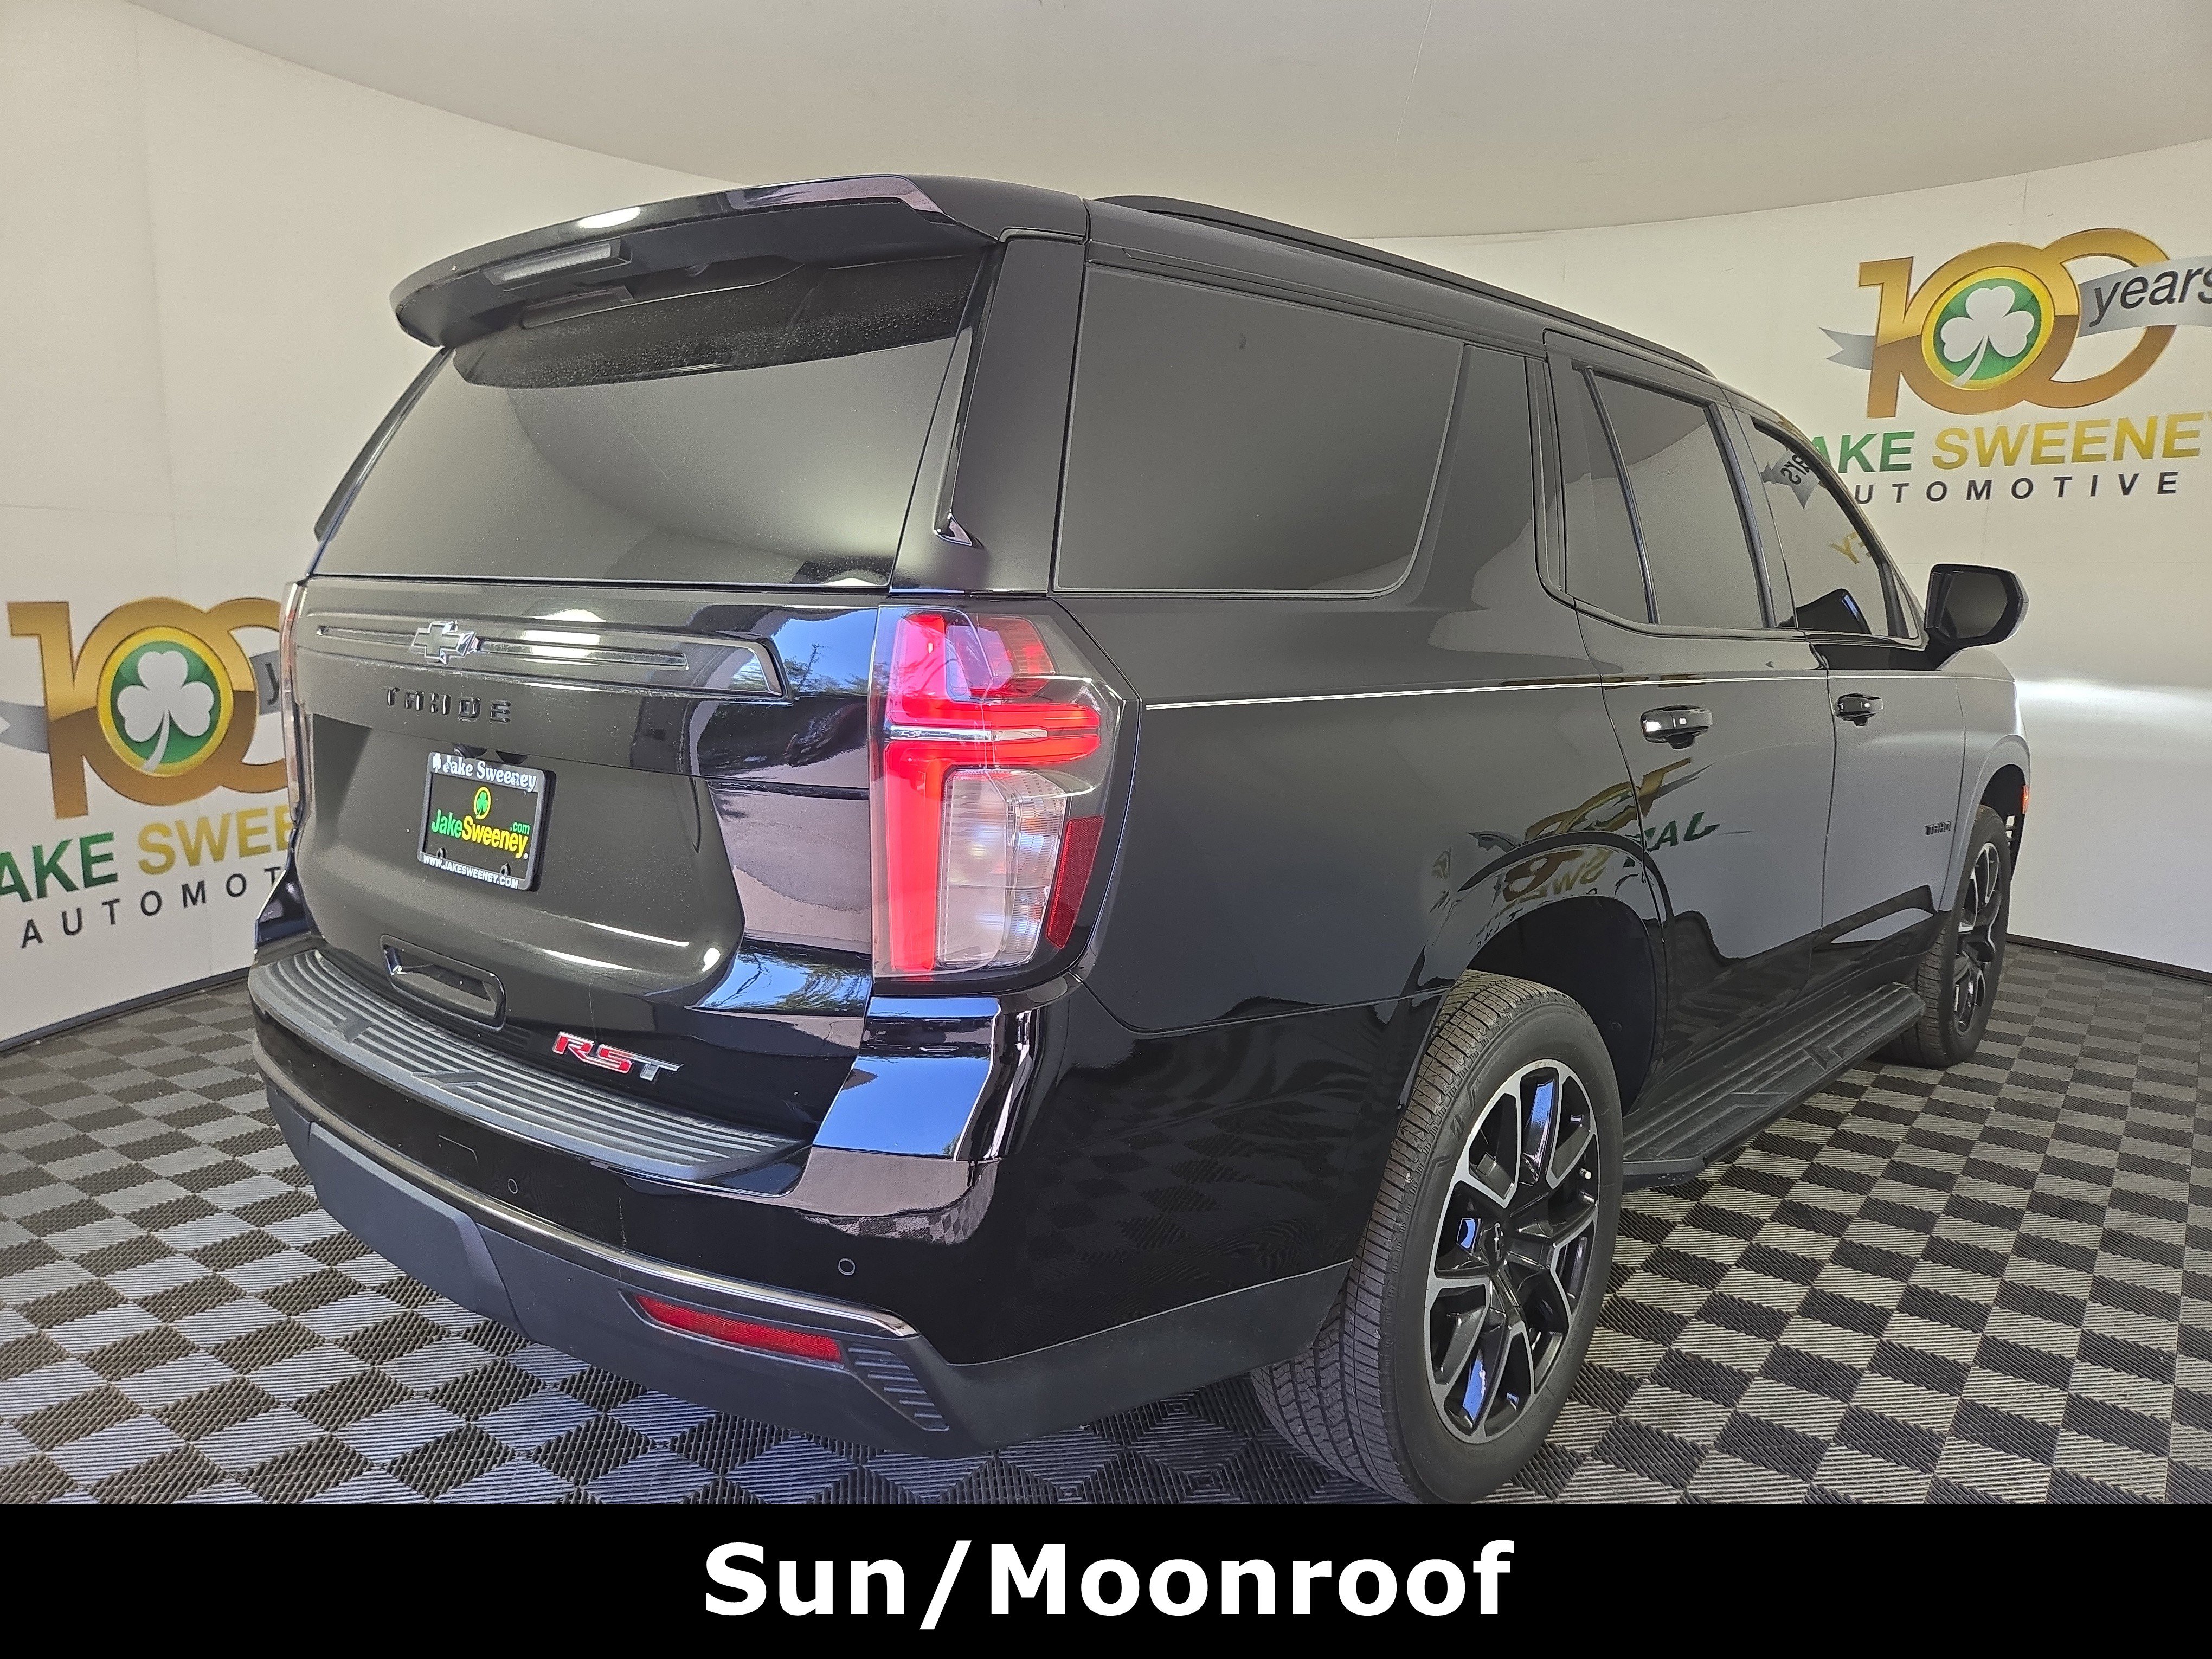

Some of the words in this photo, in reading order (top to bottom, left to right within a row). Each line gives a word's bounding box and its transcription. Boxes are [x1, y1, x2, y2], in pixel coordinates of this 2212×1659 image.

[1812, 431, 1915, 474] AKE
[1931, 411, 2212, 470] SWEENE
[1854, 471, 2179, 505] UTOMOTIVE
[381, 685, 512, 723] TAHOE
[442, 755, 473, 777] Jake
[476, 760, 537, 792] Sweeney
[0, 832, 118, 903] AKE
[137, 805, 293, 877] SWEE
[423, 854, 519, 889] WWW.JAKESWEENEY.COM
[21, 866, 281, 949] AUTOMOT
[552, 1031, 684, 1081] RST
